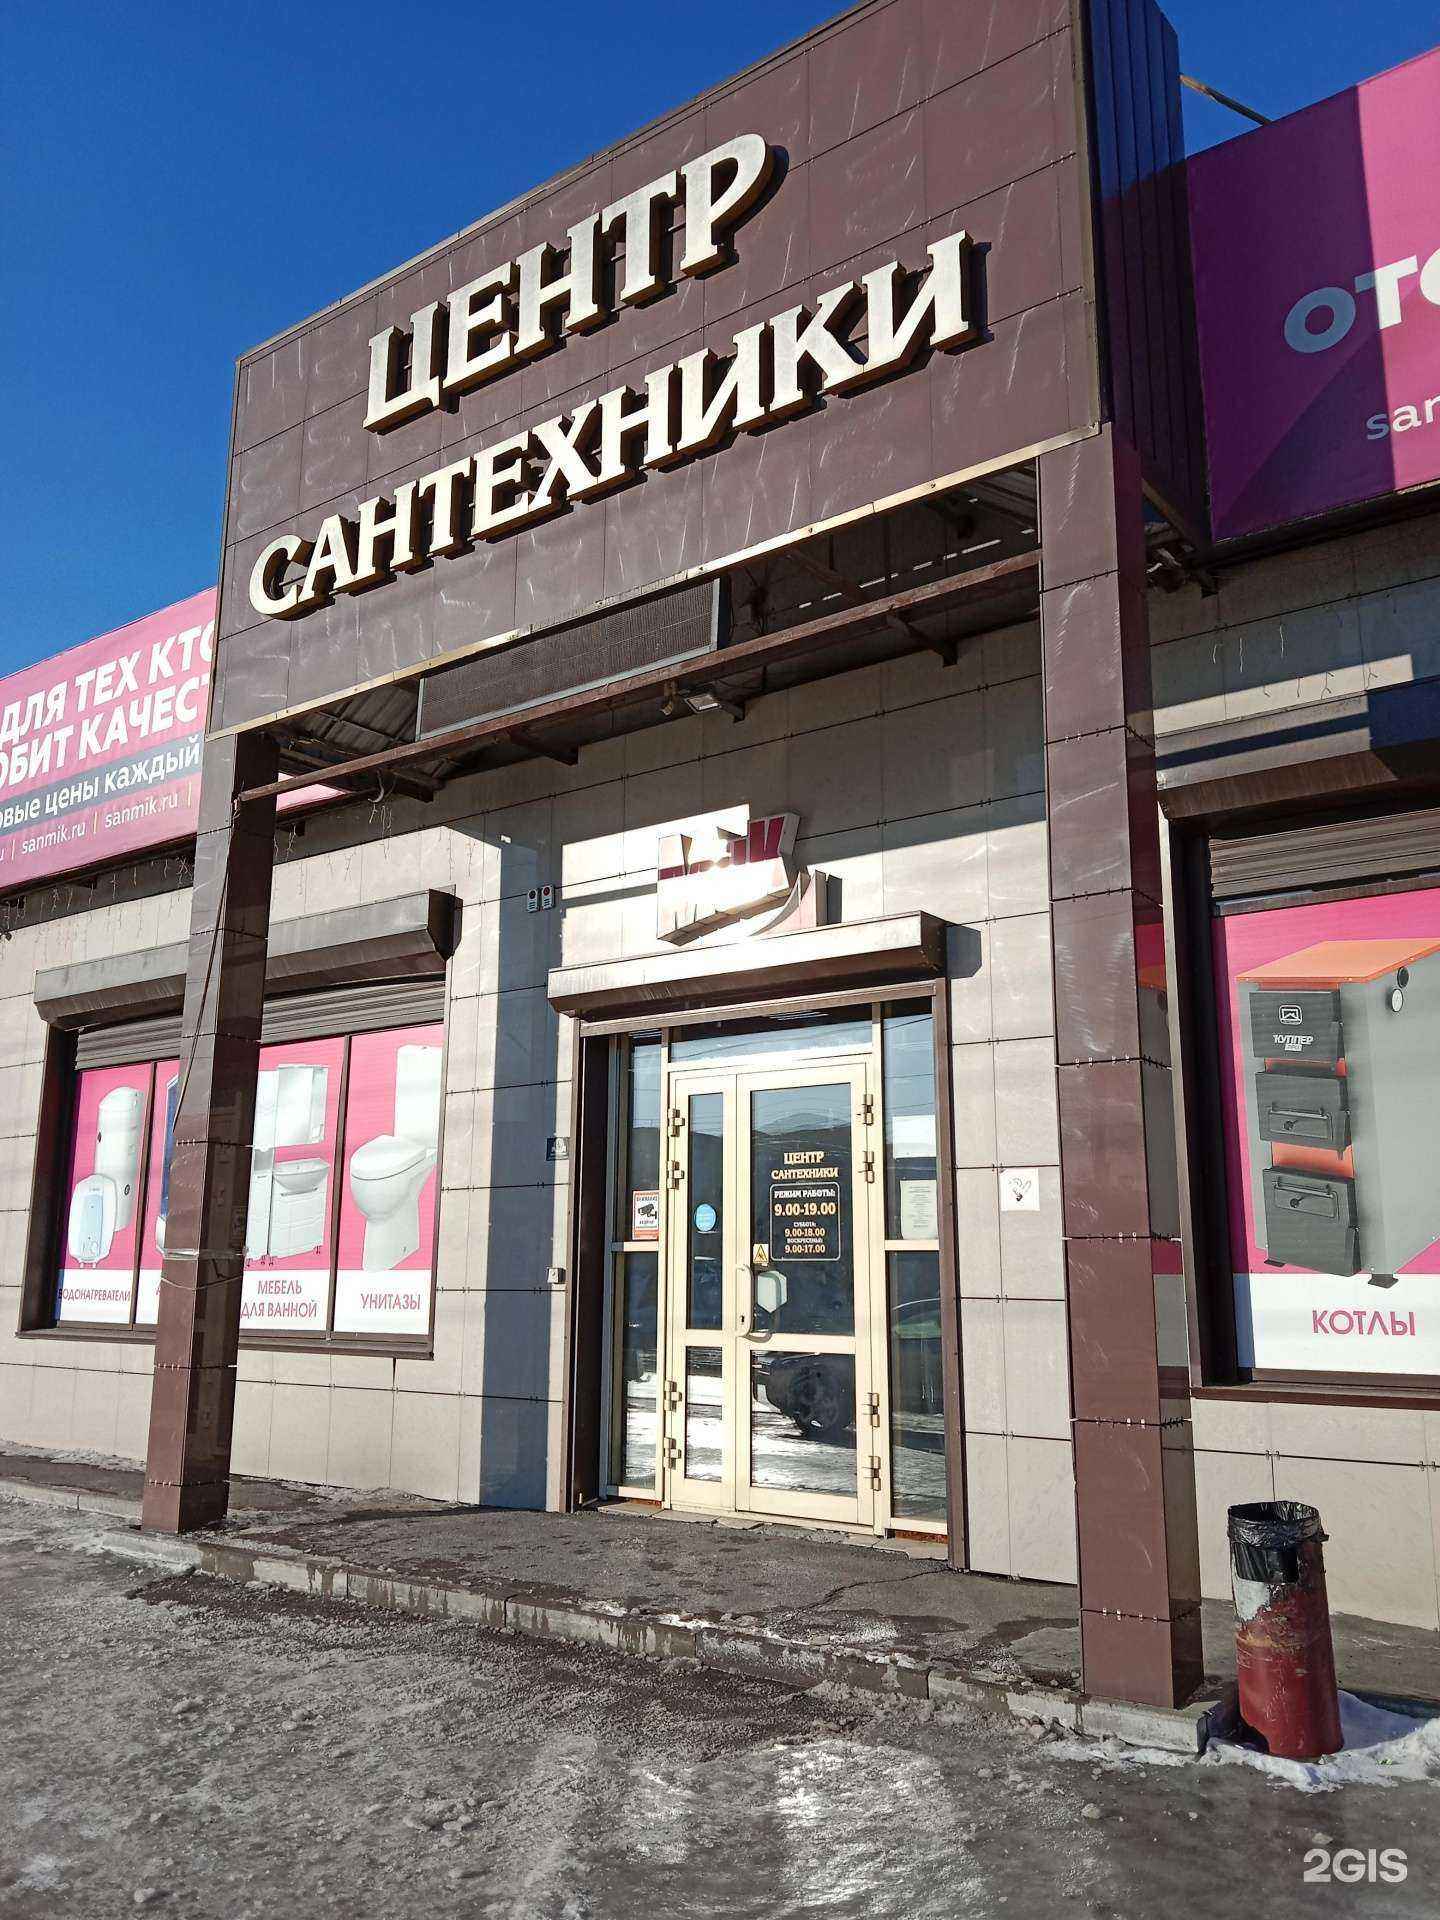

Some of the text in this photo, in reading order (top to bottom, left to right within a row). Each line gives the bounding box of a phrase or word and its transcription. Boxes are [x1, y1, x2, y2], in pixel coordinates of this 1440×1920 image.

[363, 132, 772, 433] ЦЕНТР
[249, 229, 979, 620] САНТЕХНИКИ
[0, 681, 68, 746] ДЛЯ
[75, 650, 142, 712] ТЕХ
[78, 675, 210, 761] КАЧЕС
[0, 735, 201, 830] вые цены каждый
[21, 792, 179, 854] sanmik.ru sanmik.ru
[783, 1151, 825, 1165] ЦЕНТР
[771, 1167, 839, 1180] САНТЕХНИКИ
[774, 1202, 836, 1217] 9.00-19.00
[784, 1227, 826, 1237] 9.00-18.00
[784, 1244, 826, 1254] 9.00-17.00
[257, 1279, 303, 1296] МЕБЕЛЬ
[240, 1299, 318, 1319] ДЛЯ ВАННОЙ
[360, 1292, 421, 1312] УНИТАЗЫ
[1311, 1309, 1416, 1337] КОТЛЫ
